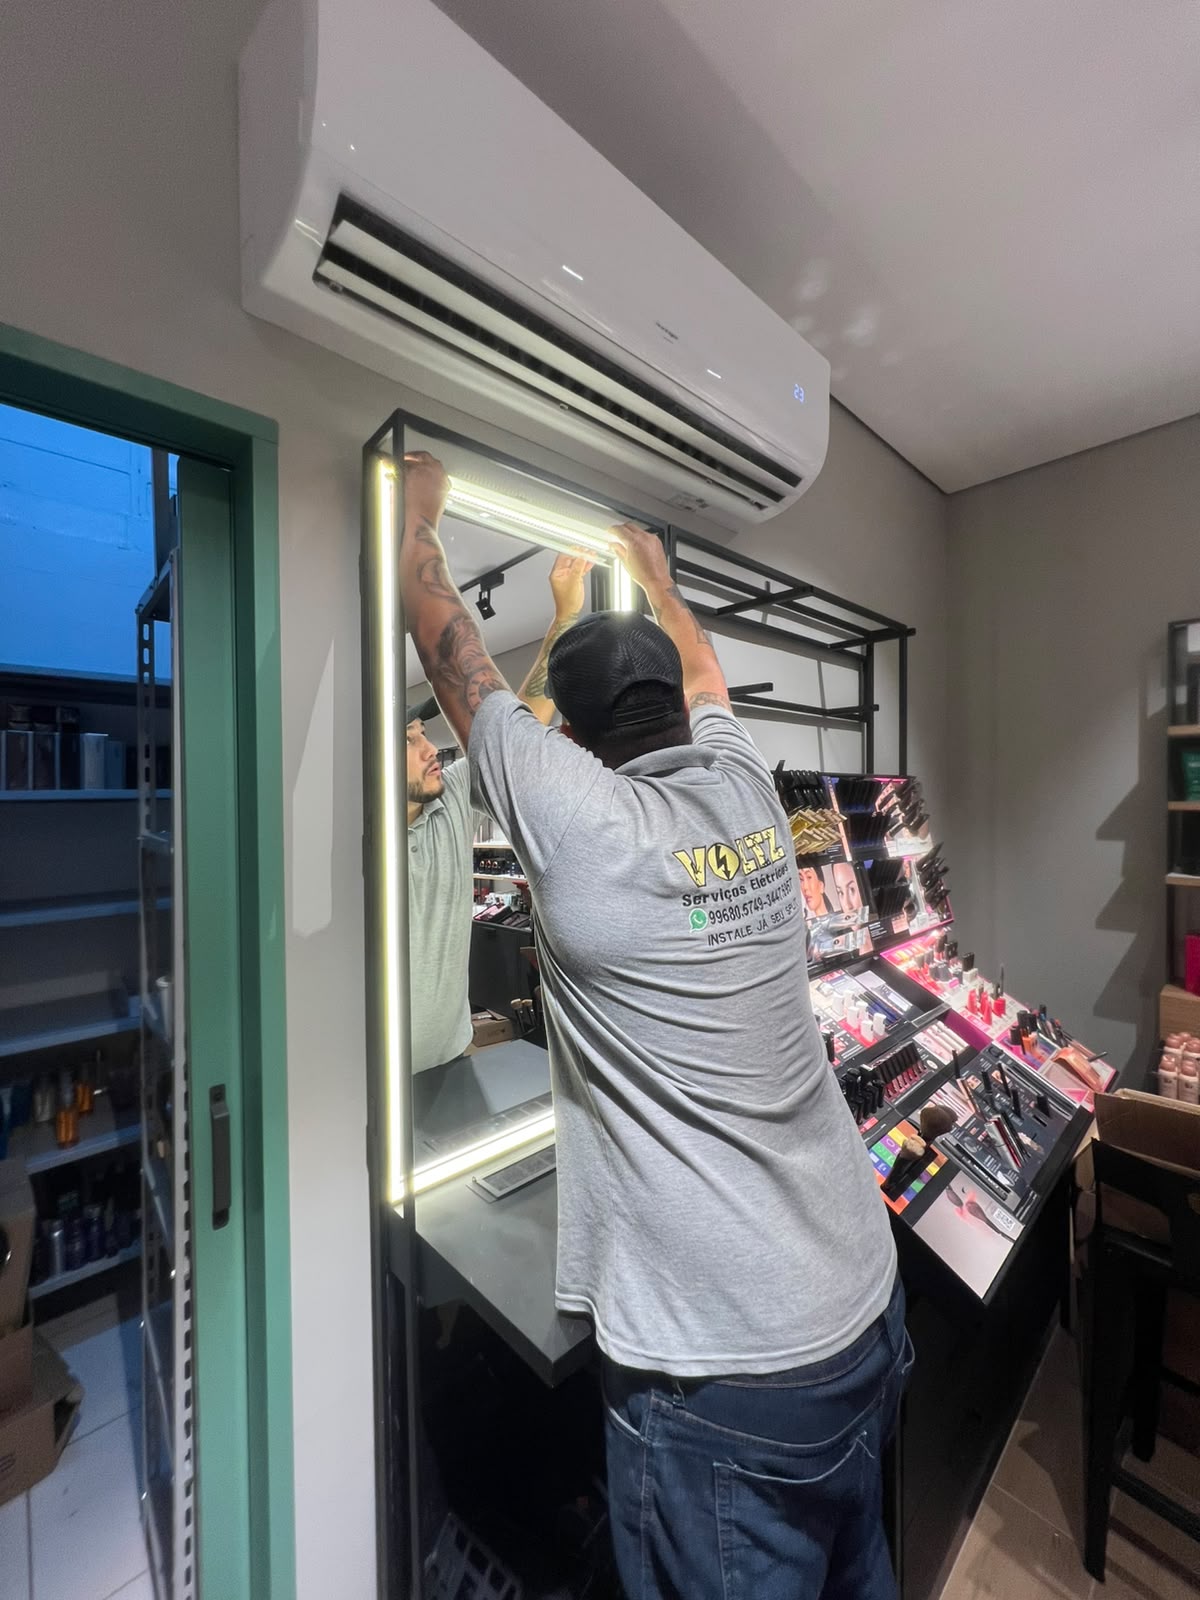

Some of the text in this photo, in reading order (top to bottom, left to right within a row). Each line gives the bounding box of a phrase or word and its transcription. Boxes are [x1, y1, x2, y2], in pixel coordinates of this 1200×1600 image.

[672, 825, 787, 888] VOLTZ
[682, 885, 747, 907] Serviços
[707, 925, 753, 946] INSTALE
[756, 913, 769, 932] JÁ
[771, 909, 785, 924] SEU
